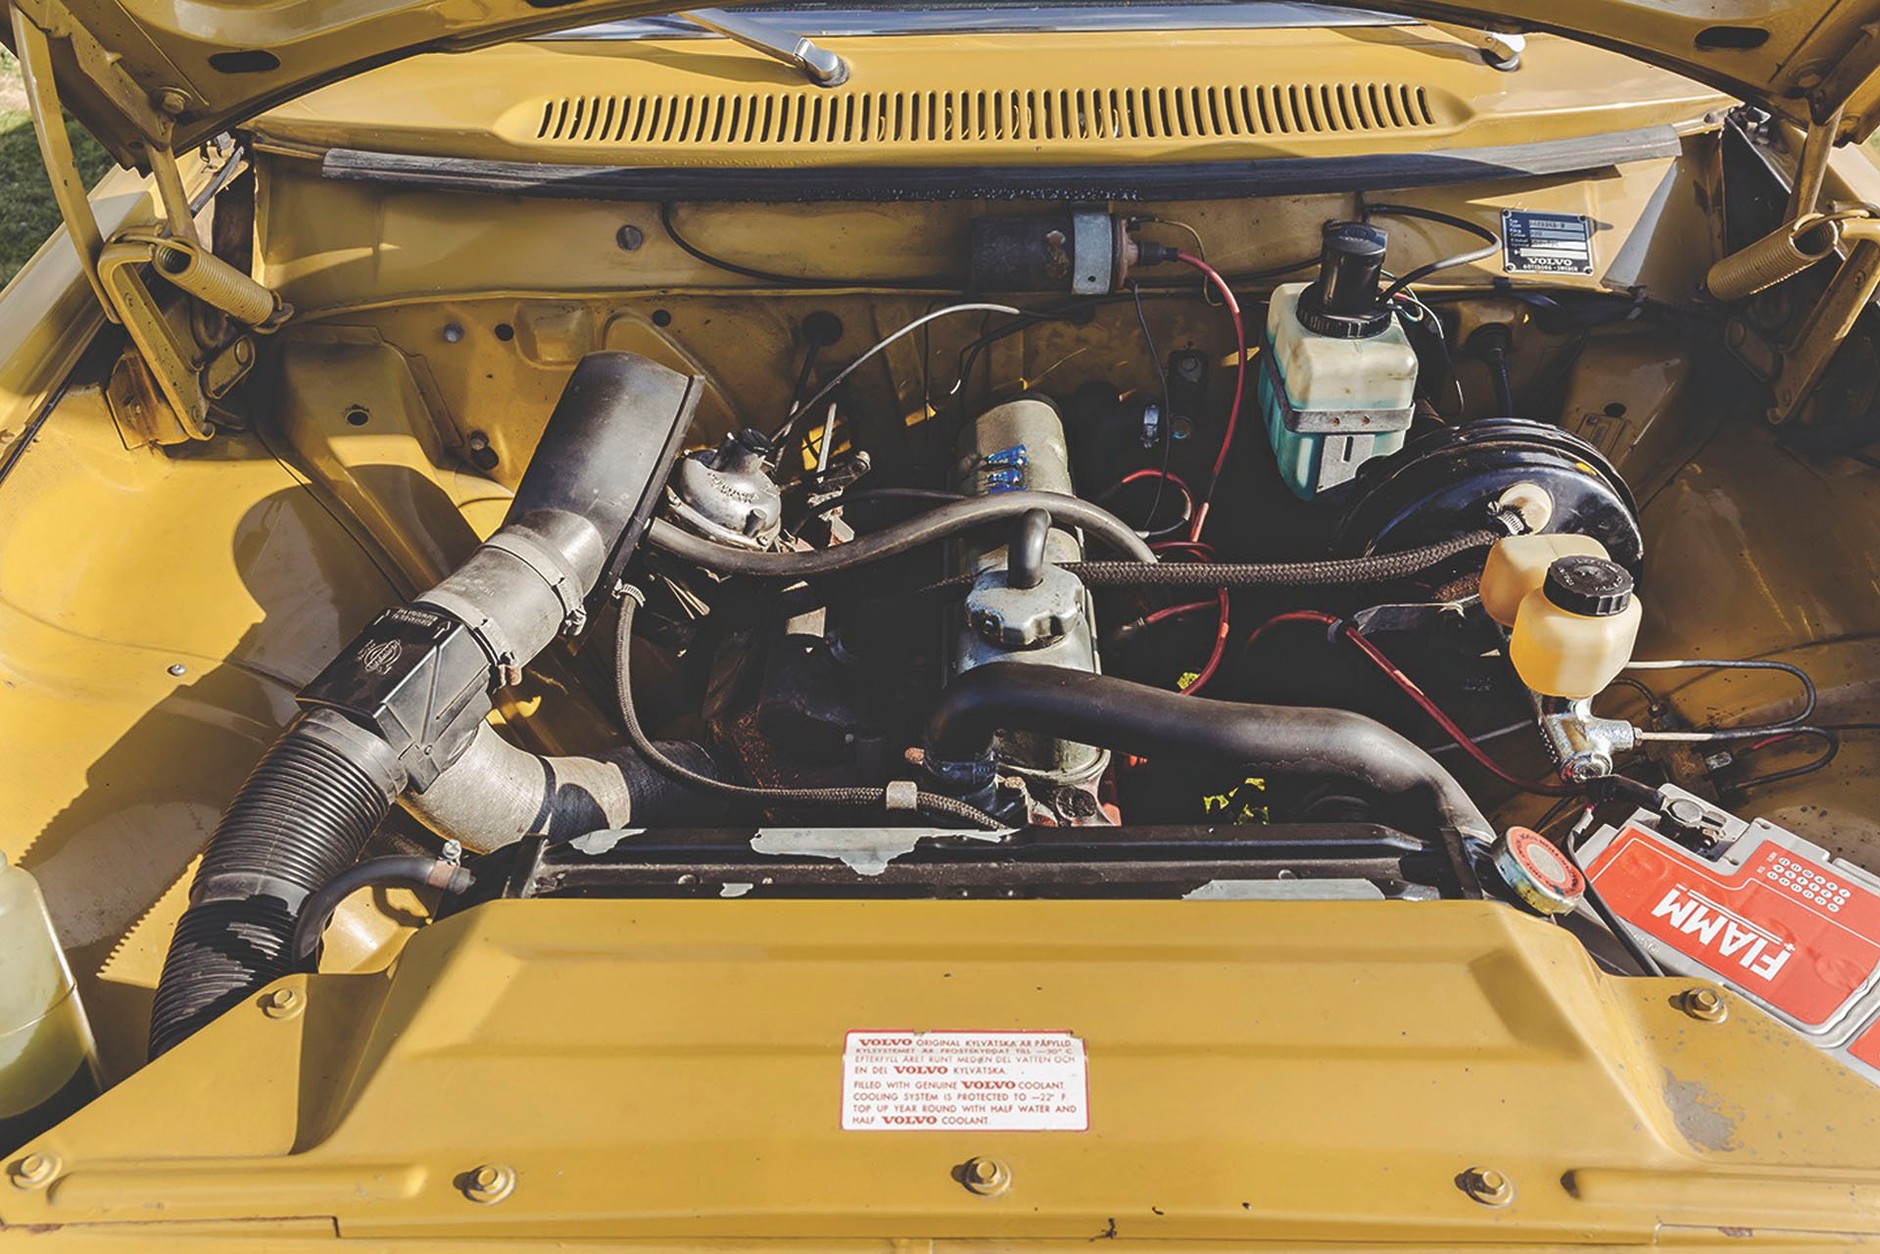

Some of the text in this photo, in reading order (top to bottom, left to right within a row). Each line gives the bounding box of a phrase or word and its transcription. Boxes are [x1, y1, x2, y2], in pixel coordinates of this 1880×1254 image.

[1651, 888, 1791, 981] FIAMM
[916, 1039, 960, 1047] ORIGINAL
[893, 1066, 948, 1074] VOLVO
[854, 1081, 881, 1089] FILLED
[886, 1081, 910, 1089] WITH
[915, 1081, 957, 1089] GENUINE
[961, 1081, 1016, 1089] VOLVO
[853, 1092, 898, 1101] COOLING
[904, 1093, 938, 1101] SYSTEM
[944, 1093, 952, 1101] IS
[957, 1093, 1009, 1101] PROTECTED
[1014, 1093, 1027, 1101] TO
[853, 1104, 1077, 1112] TOP UP YEAR ROUND WITH HALF WATER AND
[852, 1116, 875, 1124] HALF
[882, 1115, 937, 1124] VOLVO
